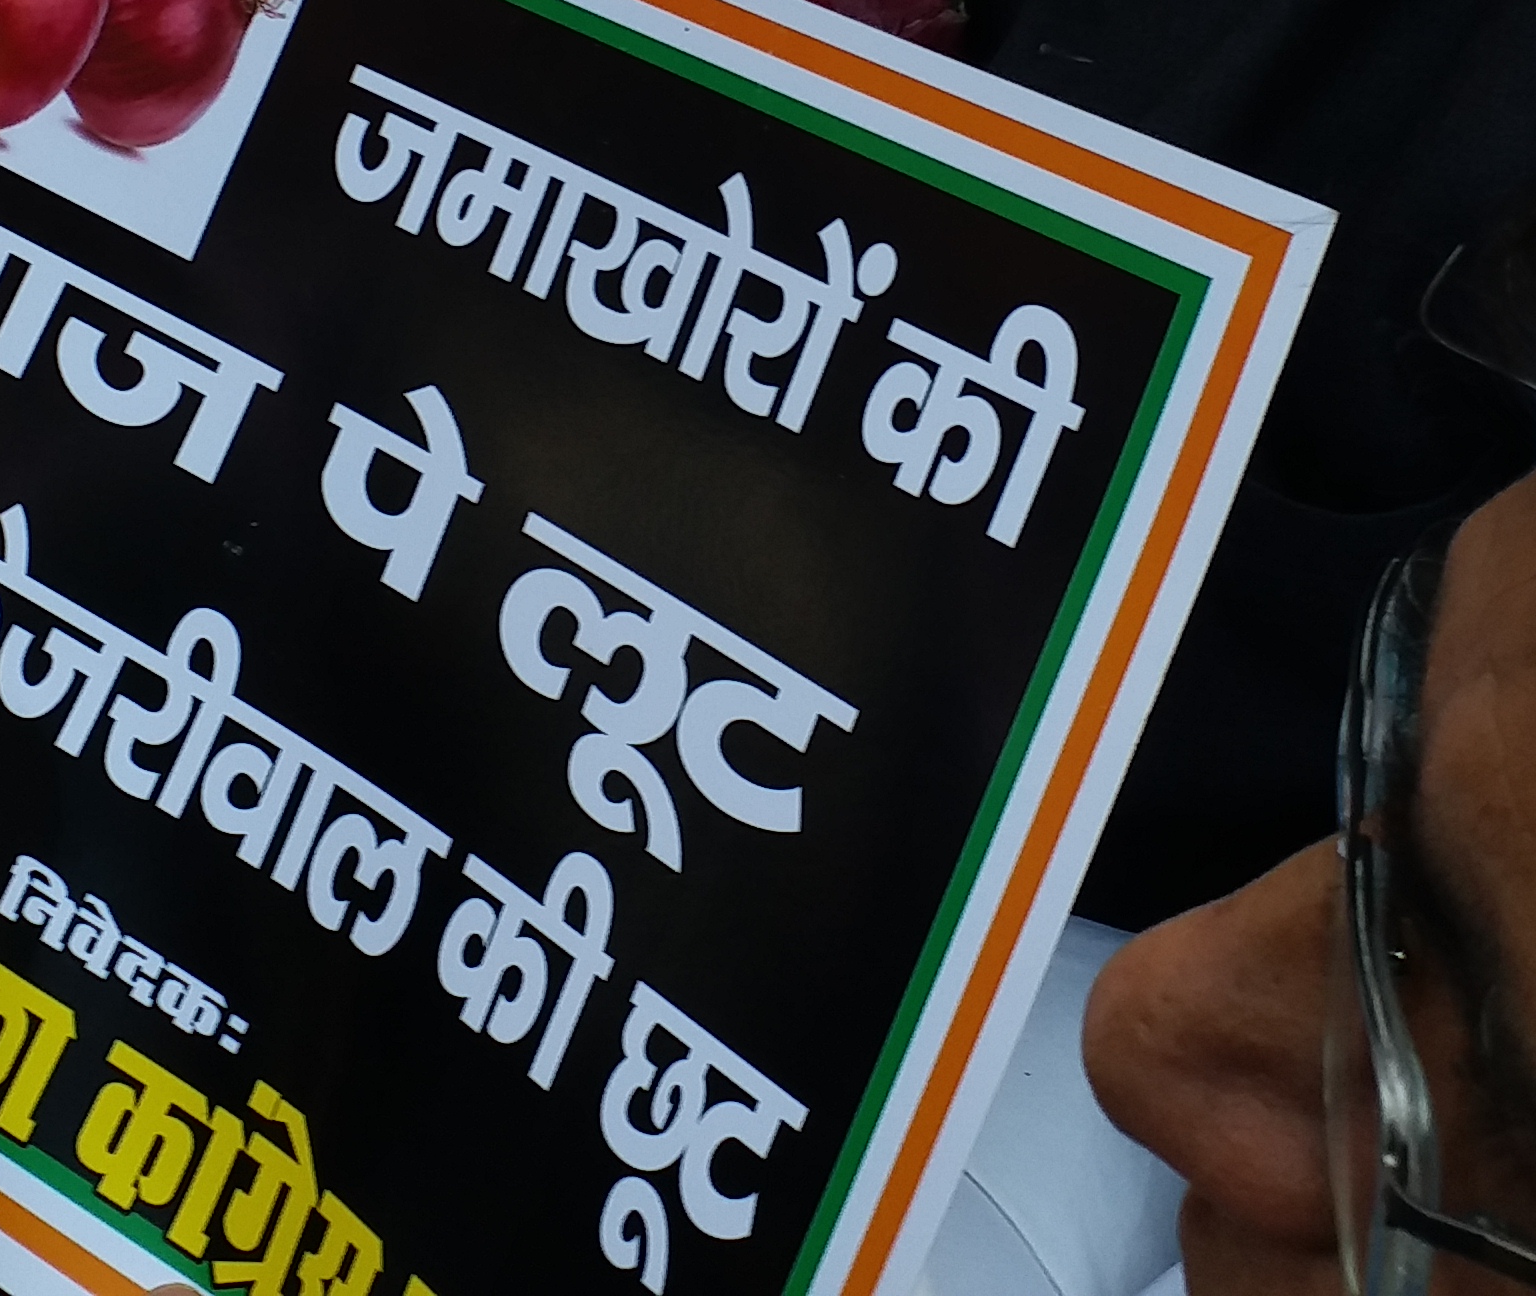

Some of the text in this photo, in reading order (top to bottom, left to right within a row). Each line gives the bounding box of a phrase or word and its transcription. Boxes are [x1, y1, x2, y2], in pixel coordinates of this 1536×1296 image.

[334, 64, 1086, 548] जमाखोरों की
[321, 384, 485, 602] पे
[499, 511, 860, 873] लूट
[437, 851, 616, 1091] की
[599, 980, 810, 1296] छूट
